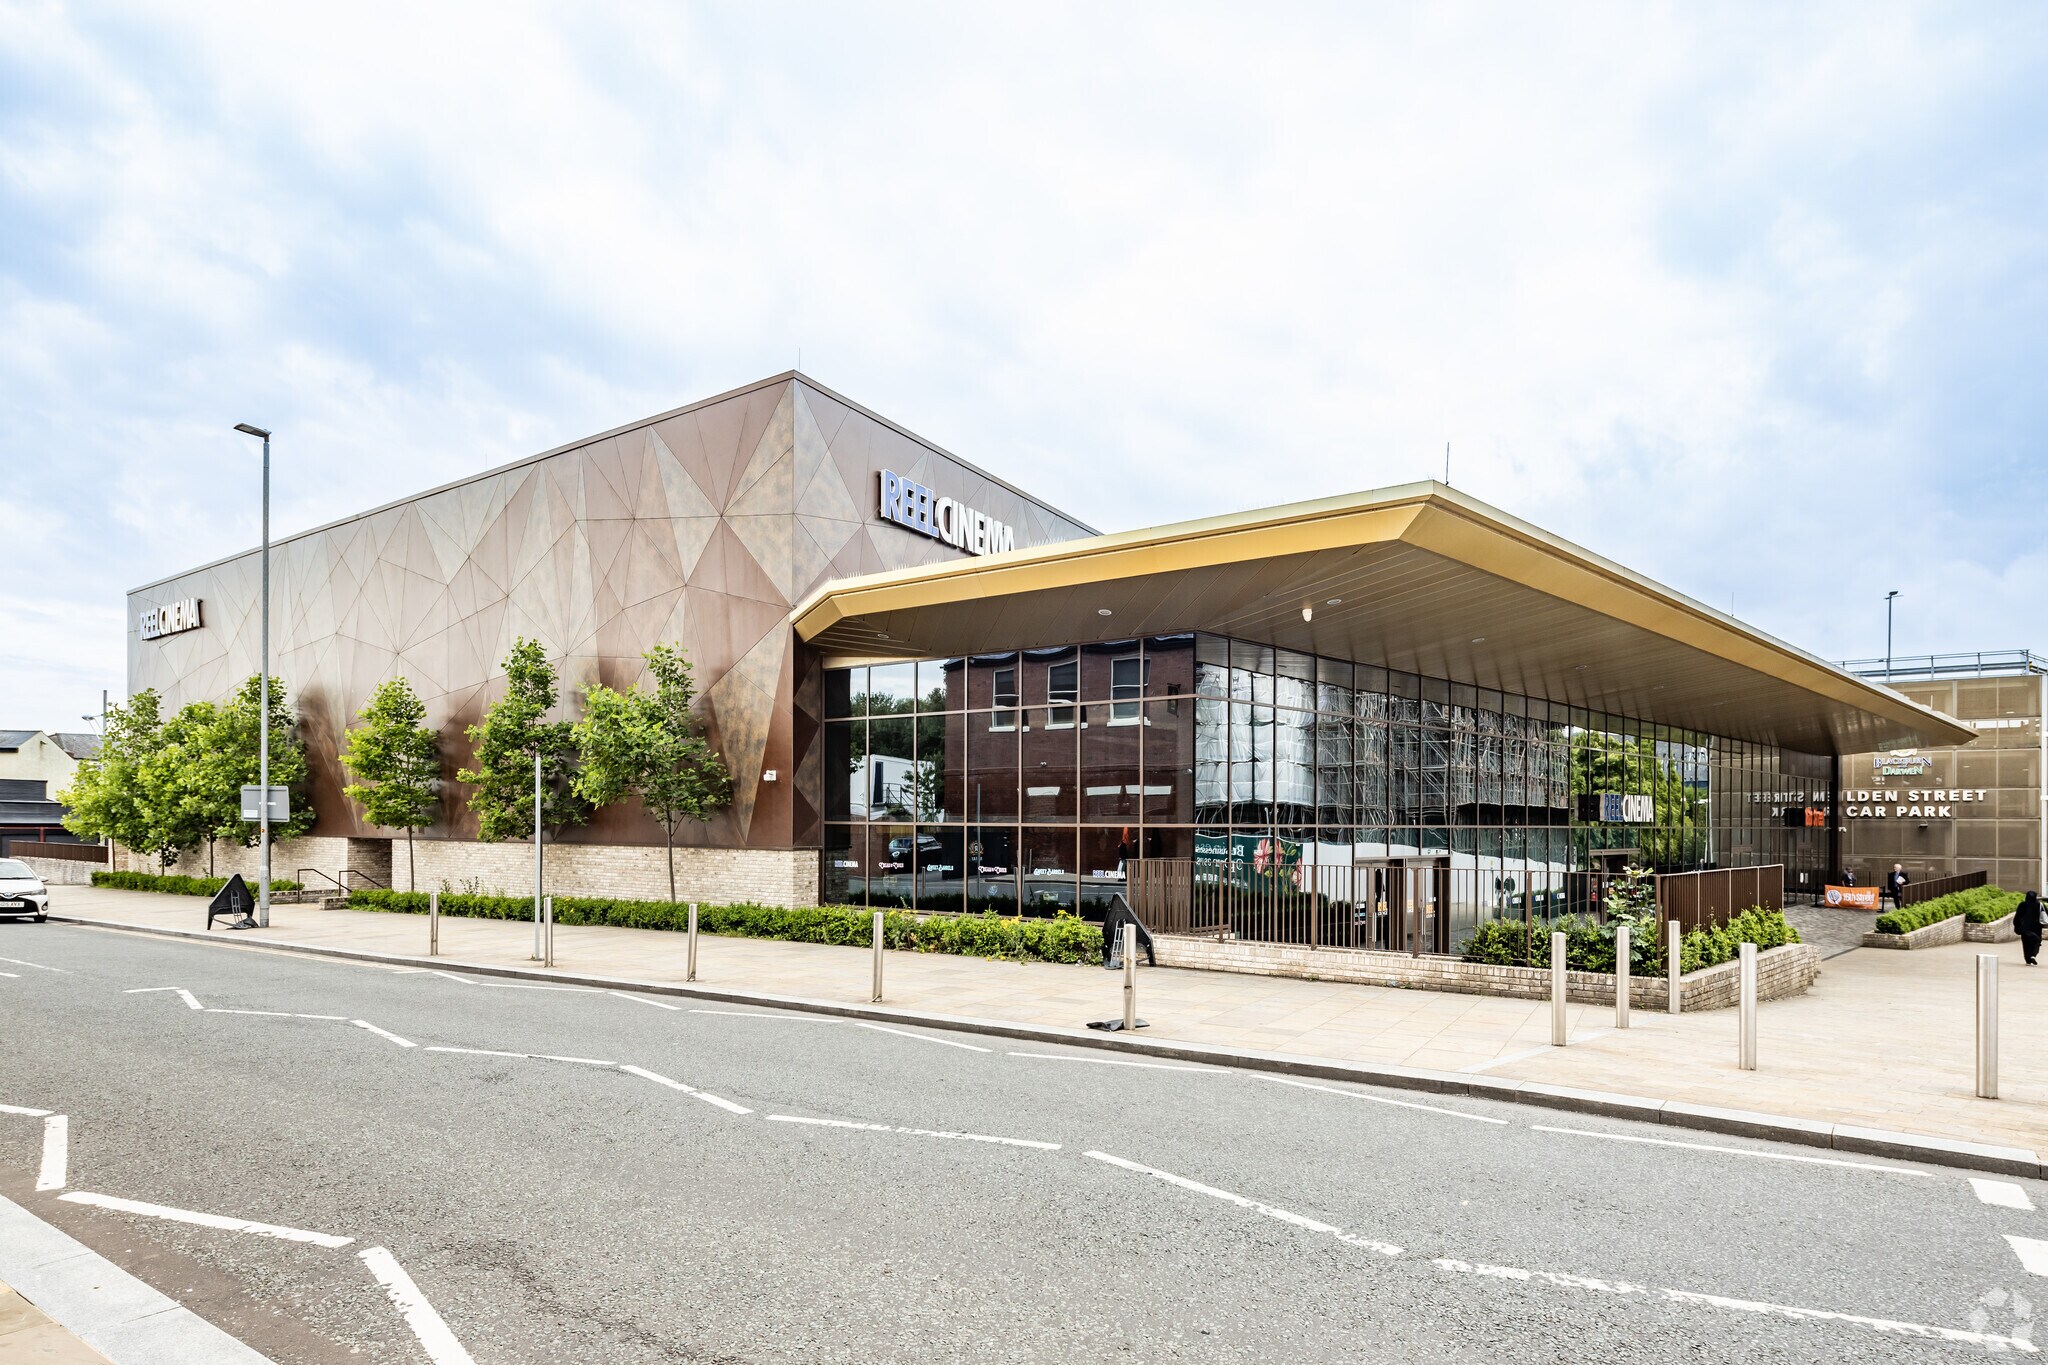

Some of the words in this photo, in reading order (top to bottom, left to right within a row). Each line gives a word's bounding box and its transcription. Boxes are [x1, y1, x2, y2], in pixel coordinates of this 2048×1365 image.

[1908, 789, 1987, 802] STREET
[1846, 806, 1887, 817] CAR
[1896, 806, 1951, 817] PARK
